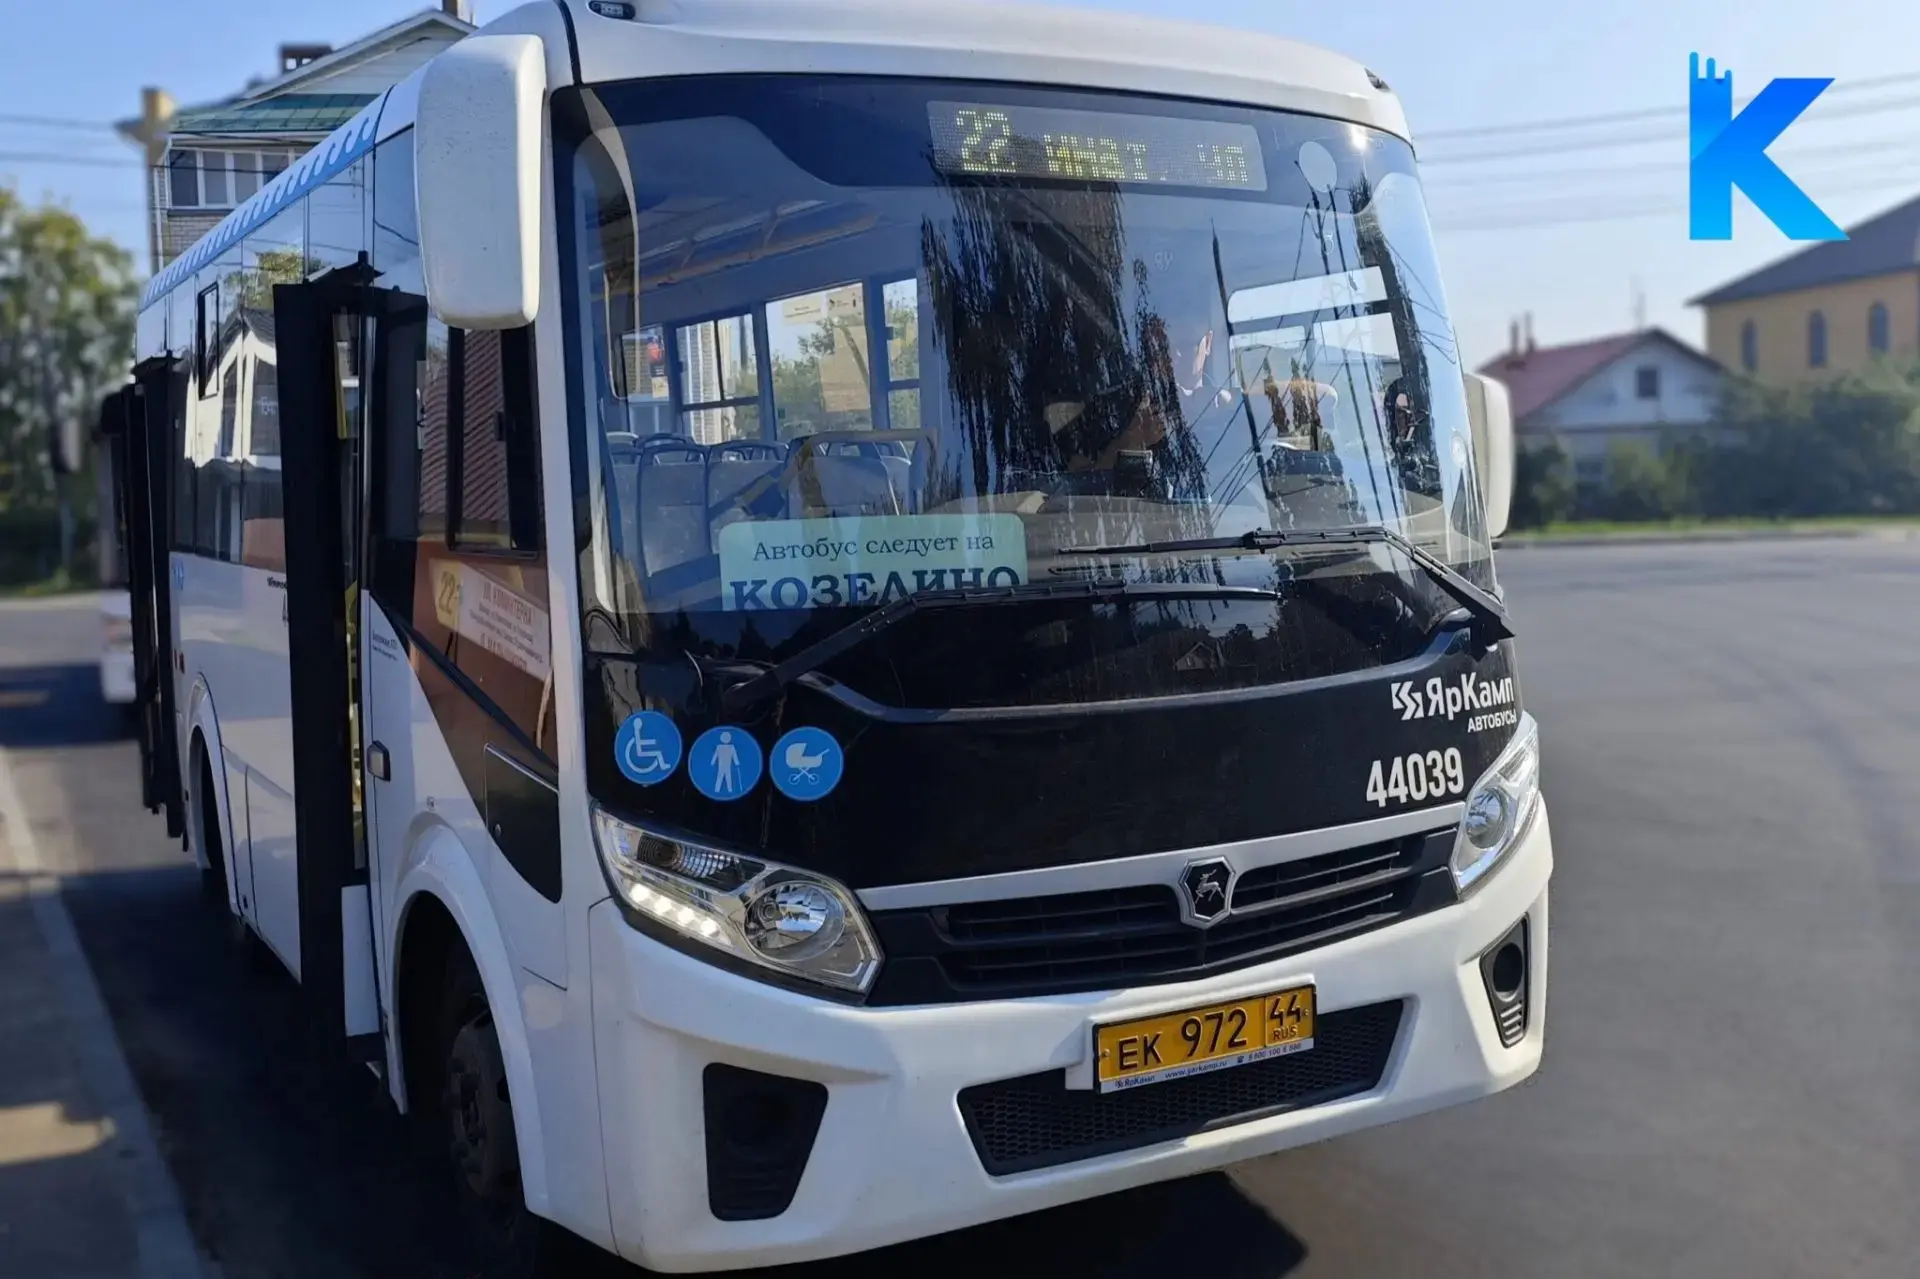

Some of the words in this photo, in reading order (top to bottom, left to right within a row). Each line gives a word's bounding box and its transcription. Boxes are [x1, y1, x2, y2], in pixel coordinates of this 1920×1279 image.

[956, 110, 1016, 173] 22
[753, 537, 857, 561] Автобус
[866, 537, 958, 558] следует
[967, 532, 994, 550] на
[729, 566, 1020, 610] КОЗЕЛИНО
[1426, 672, 1514, 720] ЯрКамп
[1468, 709, 1517, 733] АВТОБУСЫ
[1366, 747, 1464, 808] 44039
[1180, 1008, 1247, 1057] 972
[1269, 996, 1301, 1026] 44
[1272, 1027, 1298, 1041] RUS
